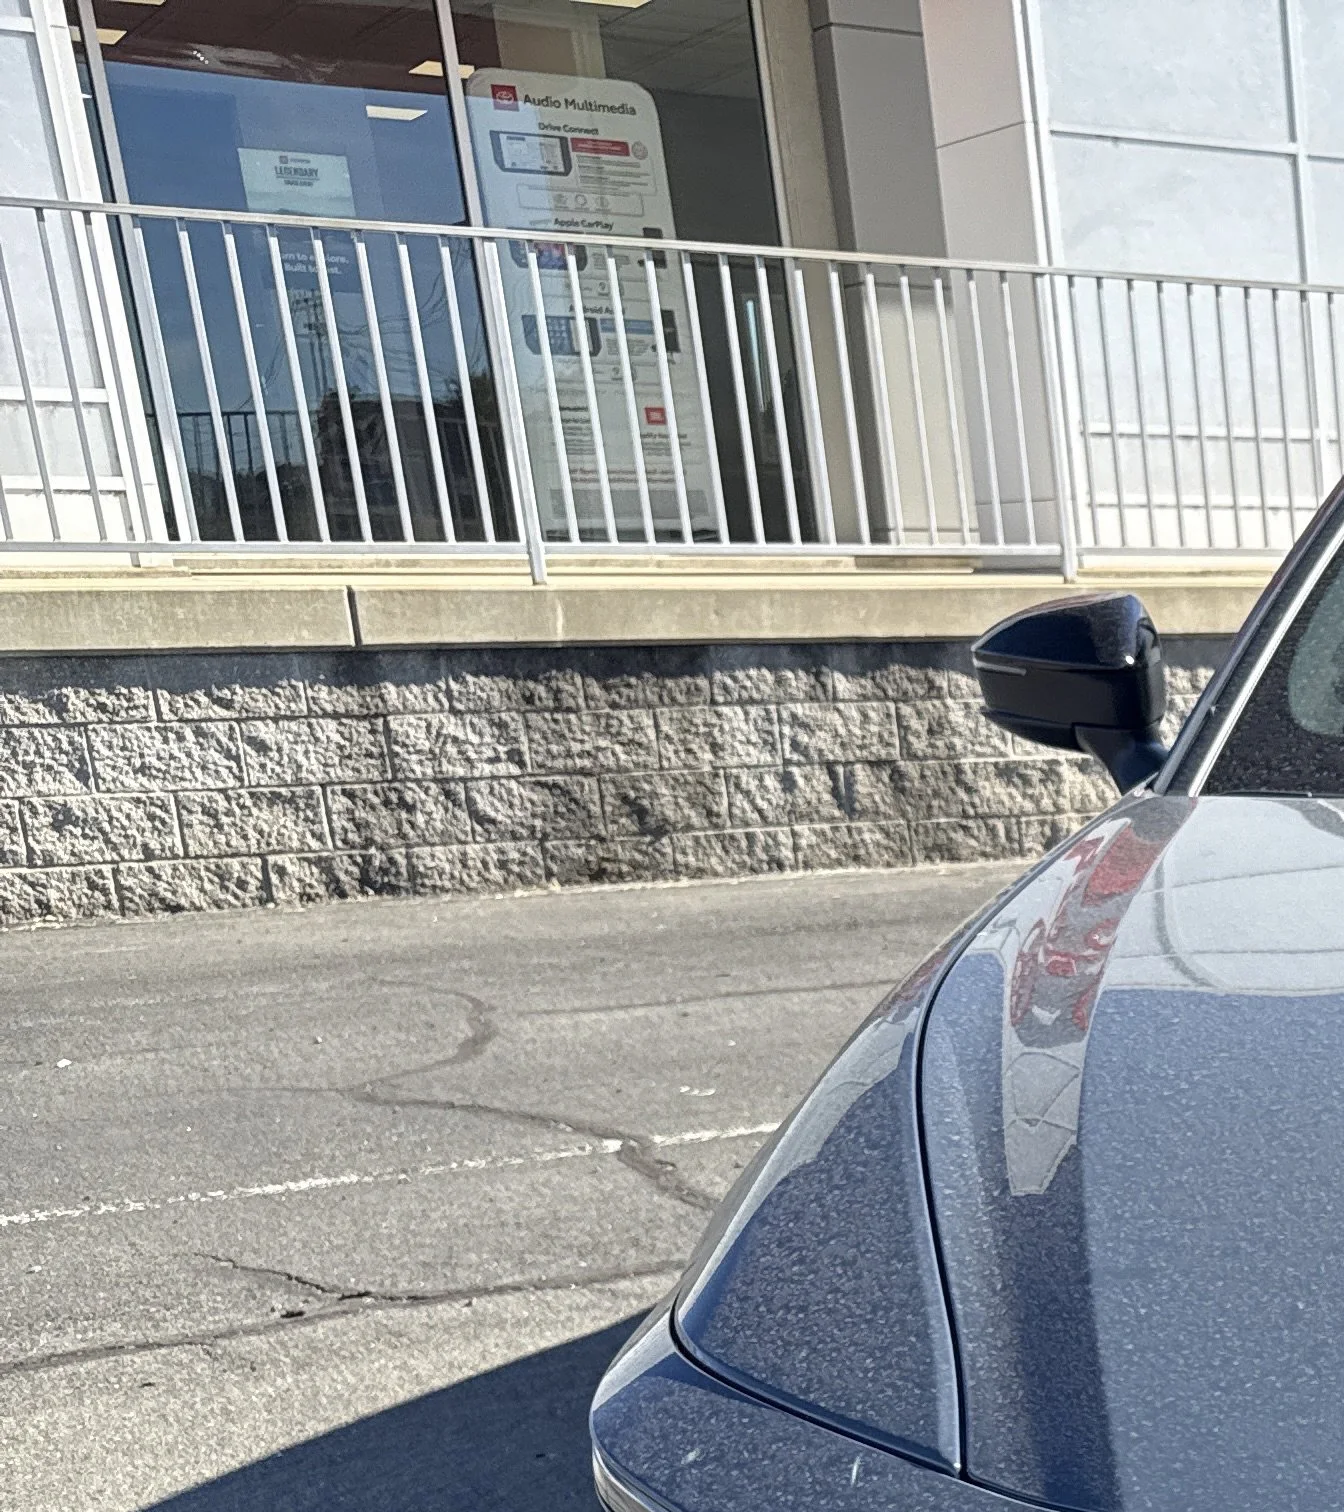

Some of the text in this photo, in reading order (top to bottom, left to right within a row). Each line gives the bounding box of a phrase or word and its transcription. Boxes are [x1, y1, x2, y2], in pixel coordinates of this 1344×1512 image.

[524, 94, 637, 116] Audio Multimedia
[538, 122, 599, 136] Drive Connect
[554, 218, 614, 231] Apple CarPlay
